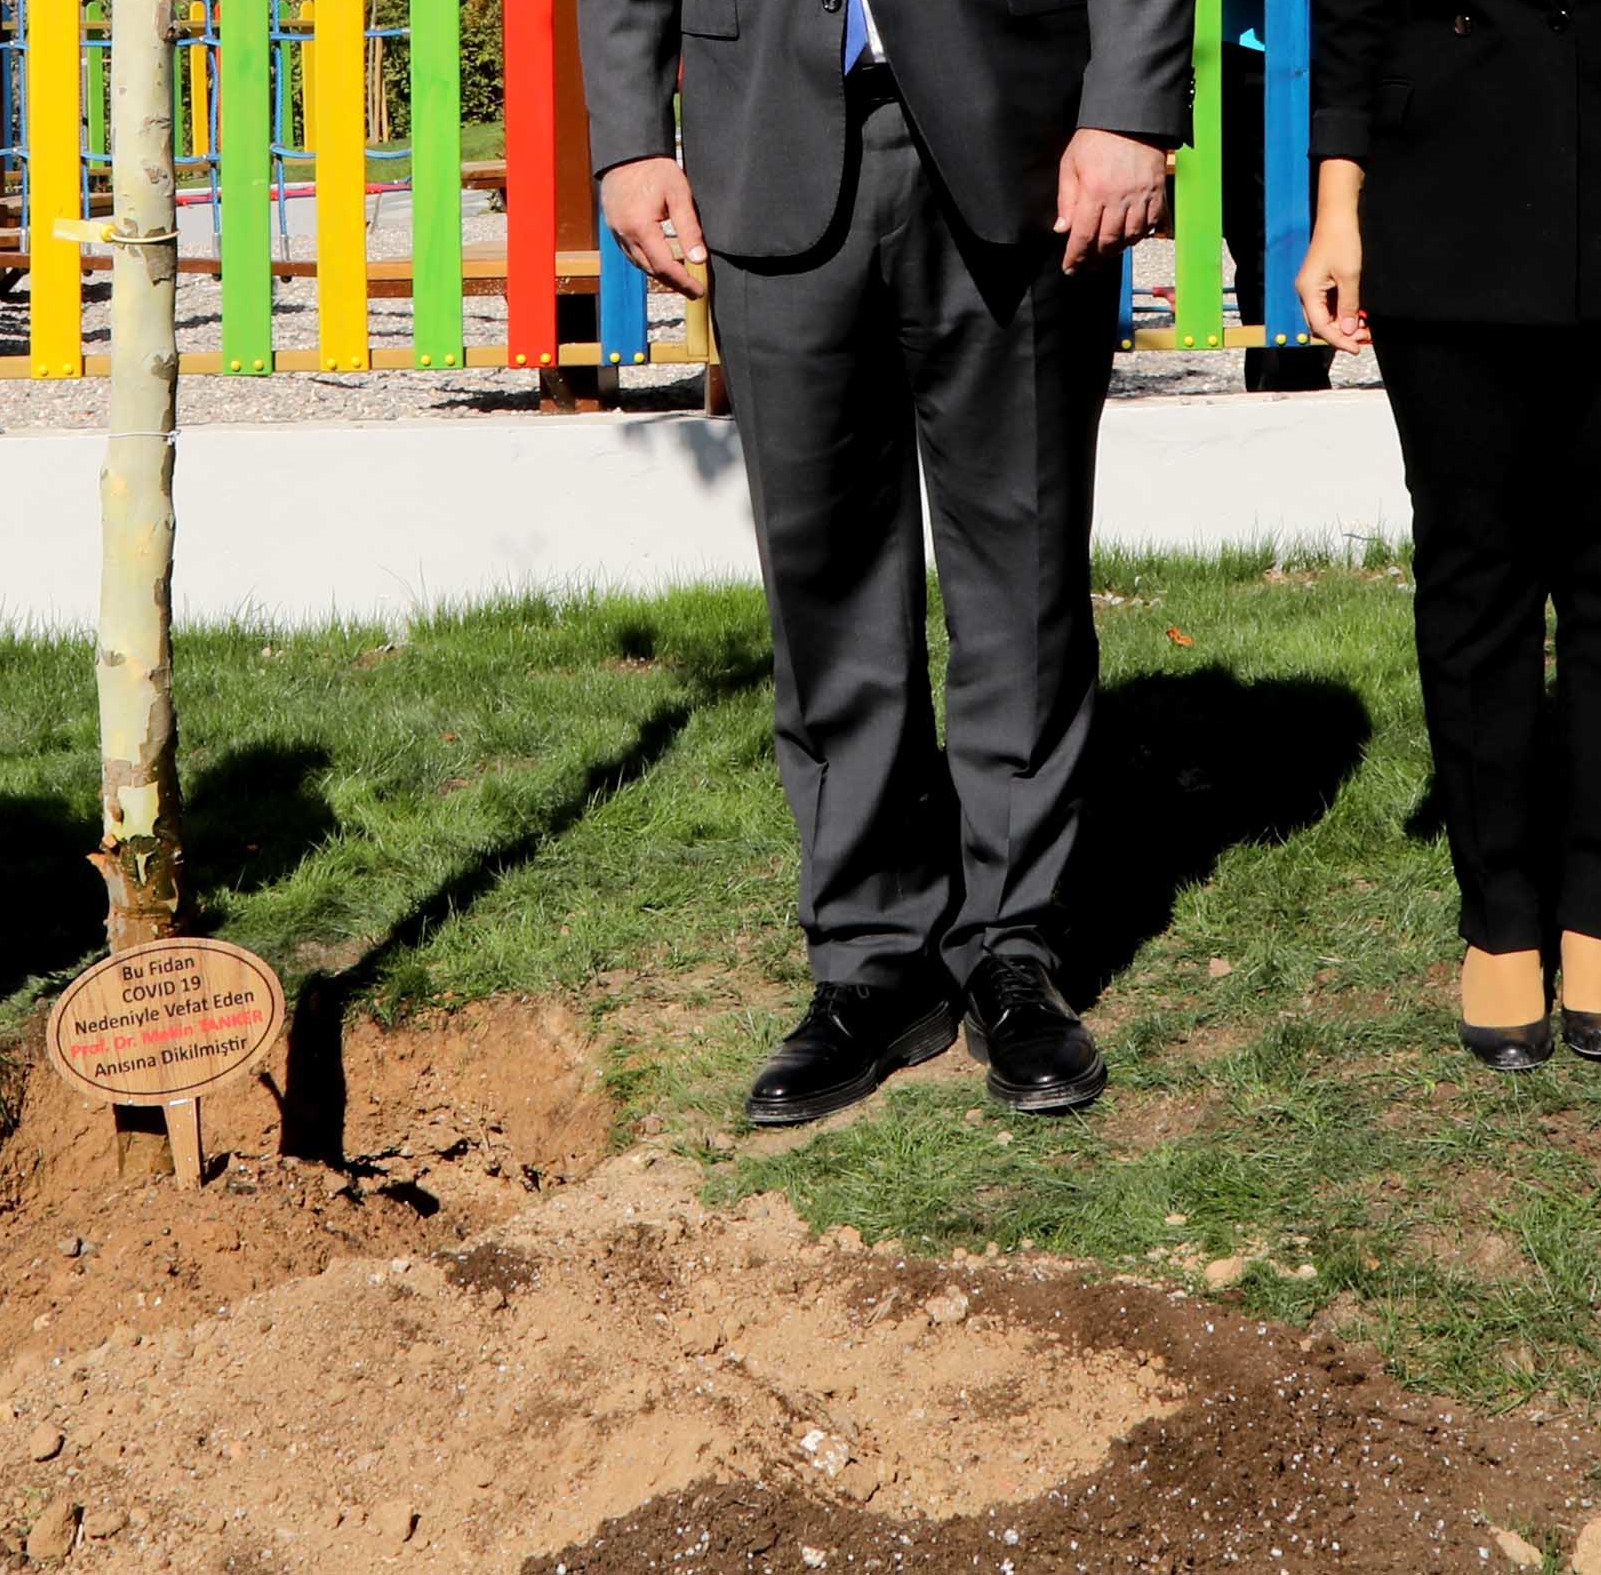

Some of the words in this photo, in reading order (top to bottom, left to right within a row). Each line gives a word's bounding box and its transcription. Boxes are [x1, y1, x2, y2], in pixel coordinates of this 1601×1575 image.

[122, 965, 144, 982] Bu
[149, 956, 195, 976] Fidan
[122, 980, 176, 1004] COVID
[182, 976, 202, 993] 19
[75, 1009, 160, 1036] Nedeniyle
[164, 998, 209, 1019] Vefat
[214, 990, 255, 1010] Eden
[70, 1040, 109, 1058] Prof.
[114, 1035, 137, 1051] Dr.
[94, 1055, 157, 1078] Anısına
[161, 1036, 248, 1065] Dikilmiştir
